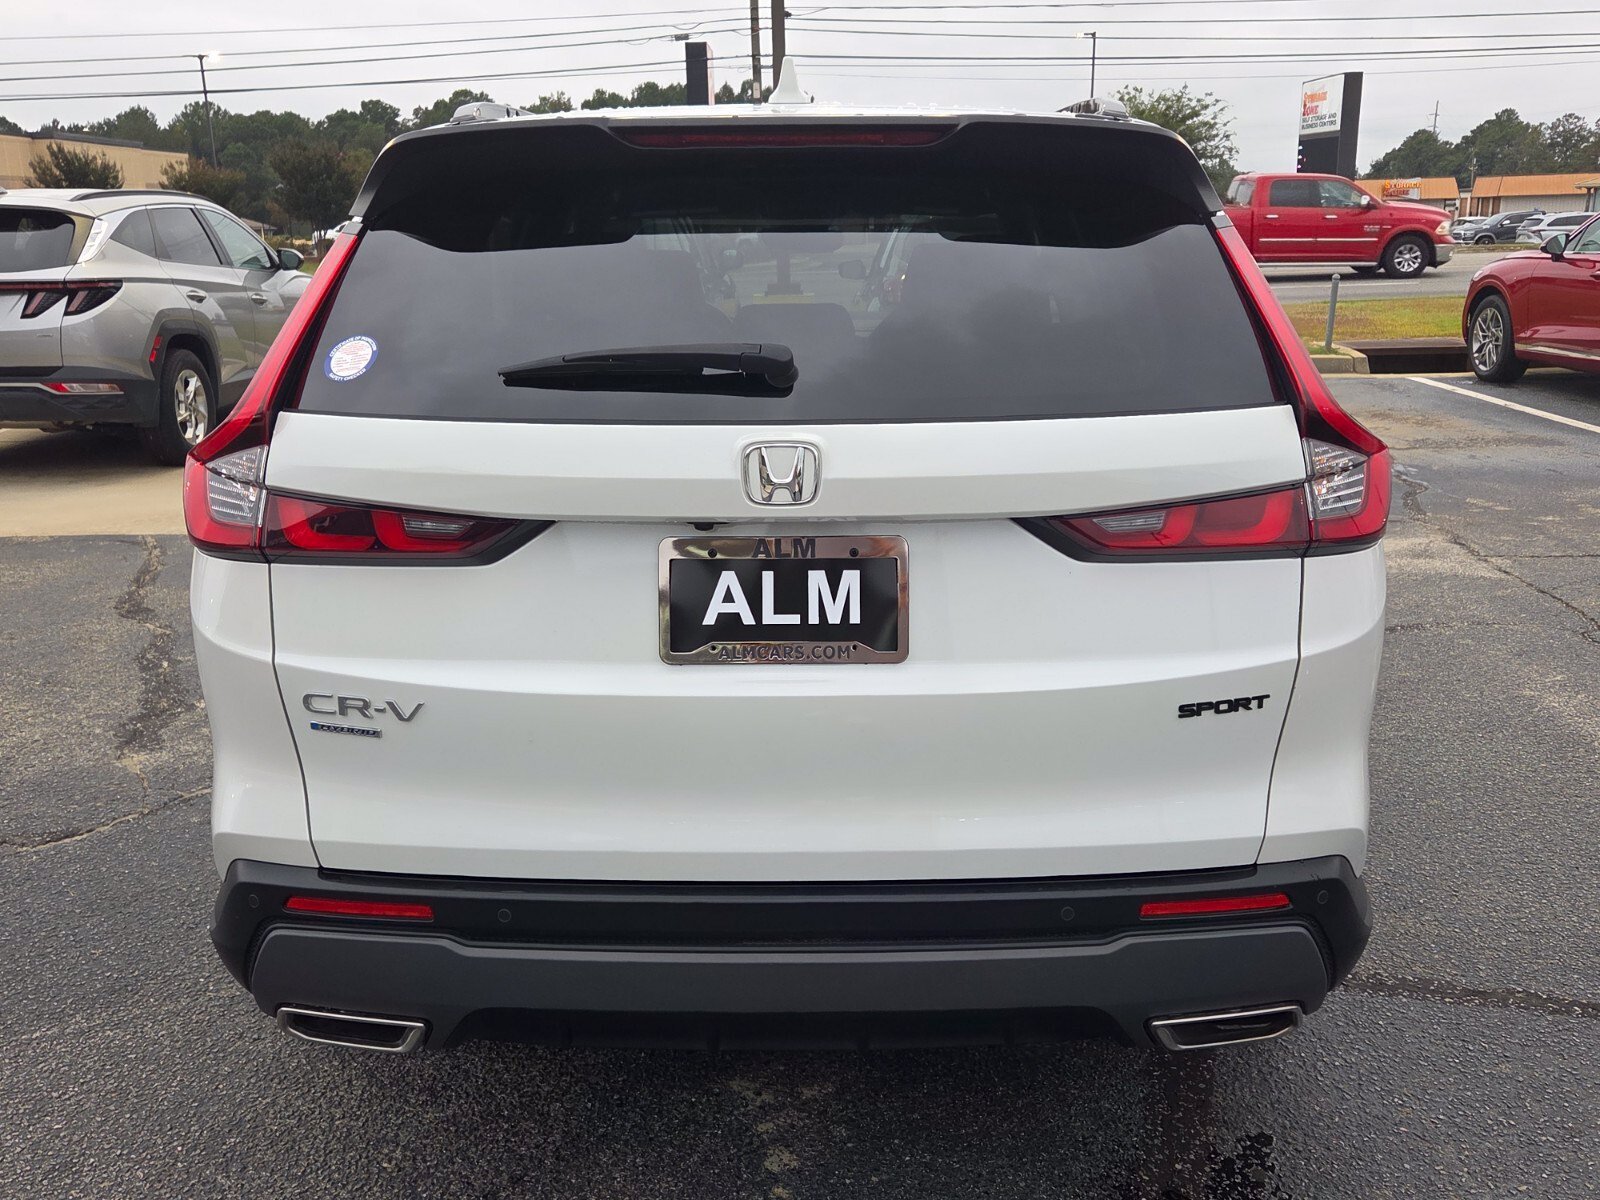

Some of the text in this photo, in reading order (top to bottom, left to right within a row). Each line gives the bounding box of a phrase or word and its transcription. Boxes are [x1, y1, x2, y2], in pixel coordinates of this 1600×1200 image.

[751, 538, 816, 558] ALM
[702, 570, 861, 625] ALM
[718, 645, 850, 661] ALMCARS.COM
[302, 692, 425, 721] CR-V
[1178, 694, 1271, 718] SPORT
